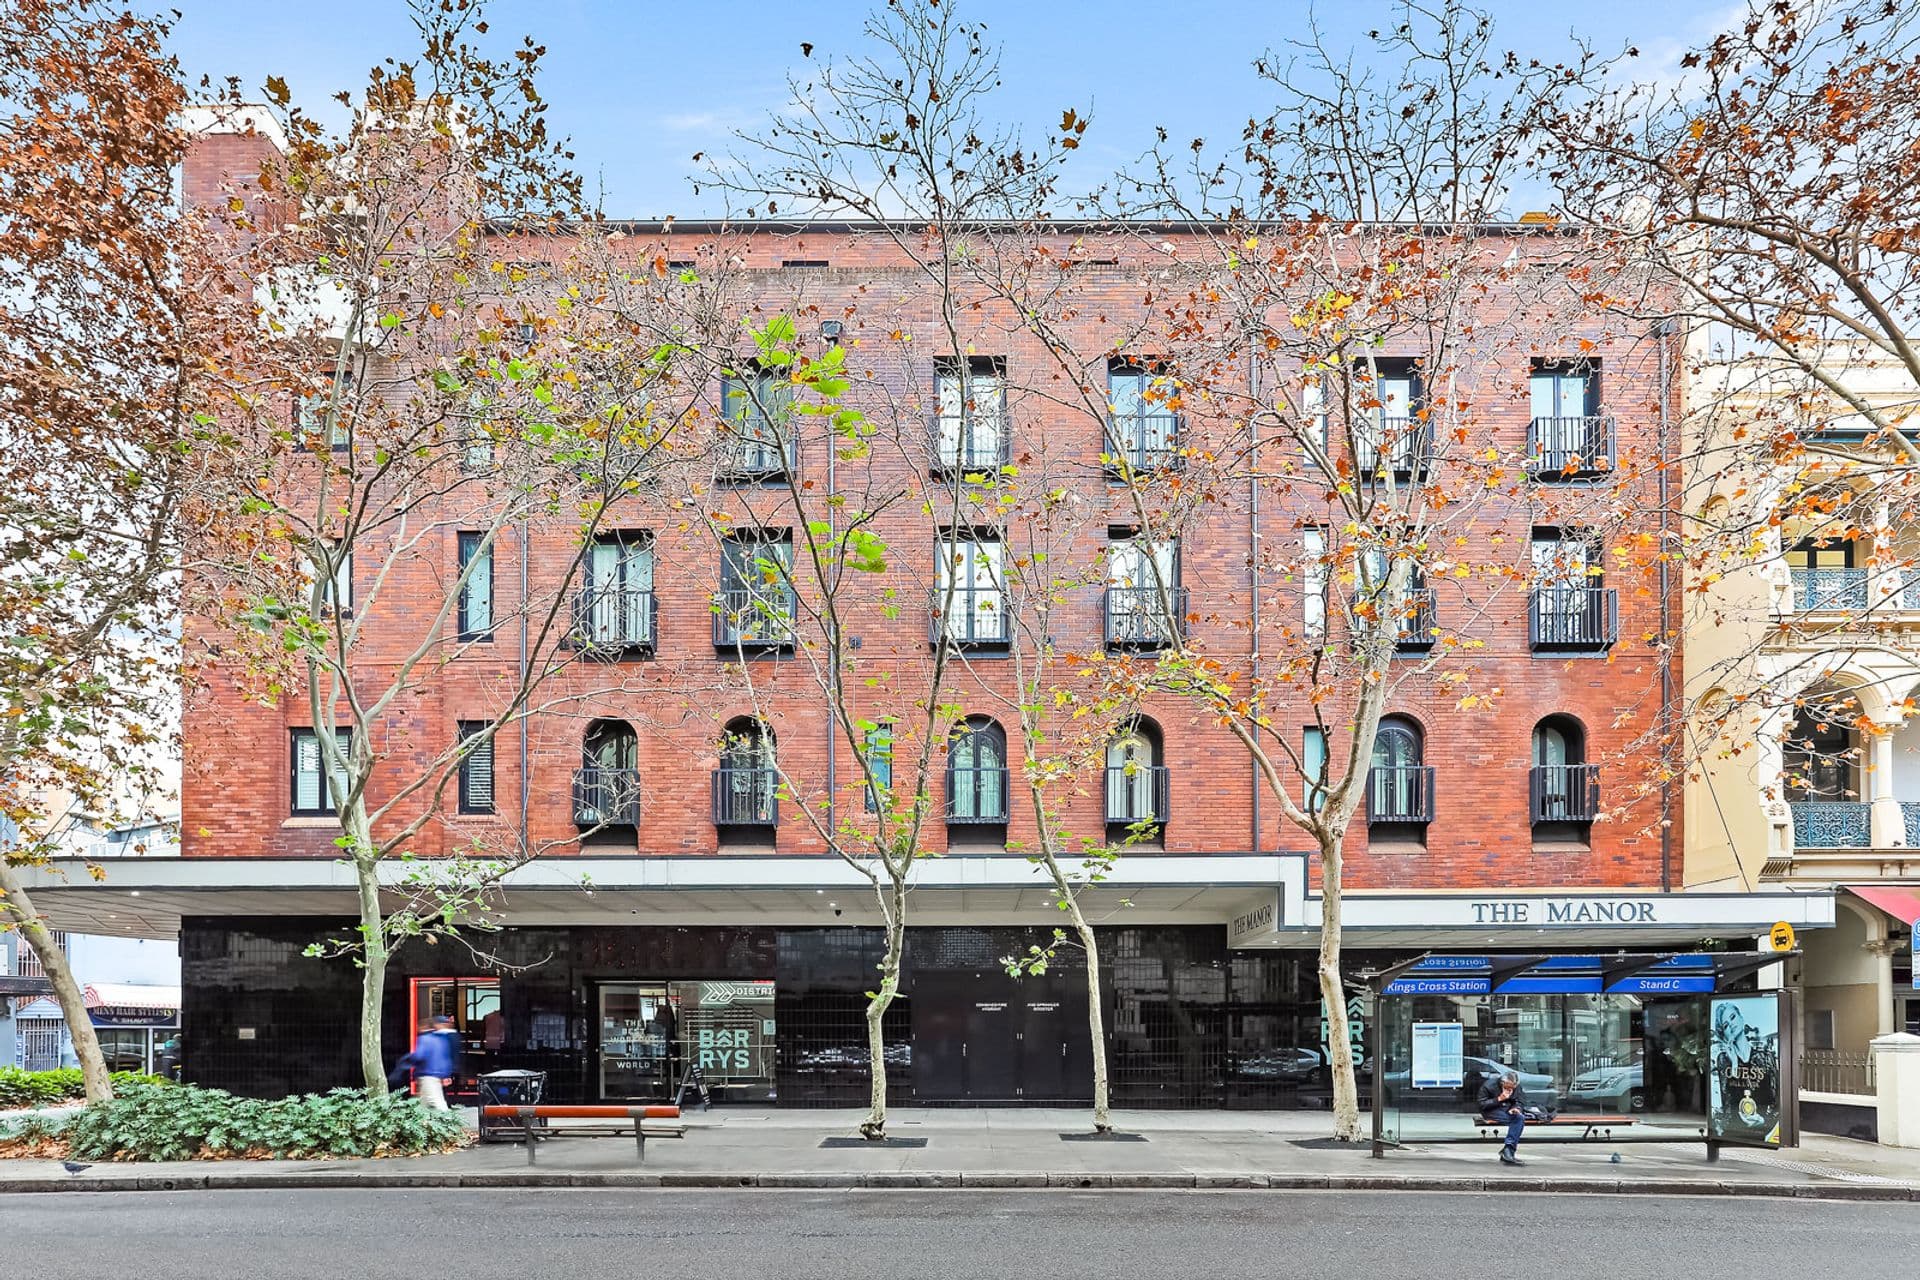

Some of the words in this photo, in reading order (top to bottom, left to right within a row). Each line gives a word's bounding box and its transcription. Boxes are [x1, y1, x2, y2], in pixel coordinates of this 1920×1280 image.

[1471, 902, 1529, 923] THE
[1547, 902, 1657, 922] MANOR
[1233, 915, 1246, 936] THE
[1246, 904, 1272, 931] MANOR
[1387, 982, 1416, 993] Kings
[1418, 982, 1447, 991] Cross
[1449, 981, 1487, 990] Station
[1640, 980, 1670, 989] Stand
[1672, 980, 1680, 989] C
[616, 1061, 650, 1069] WORLD
[1725, 1066, 1765, 1080] GUESS
